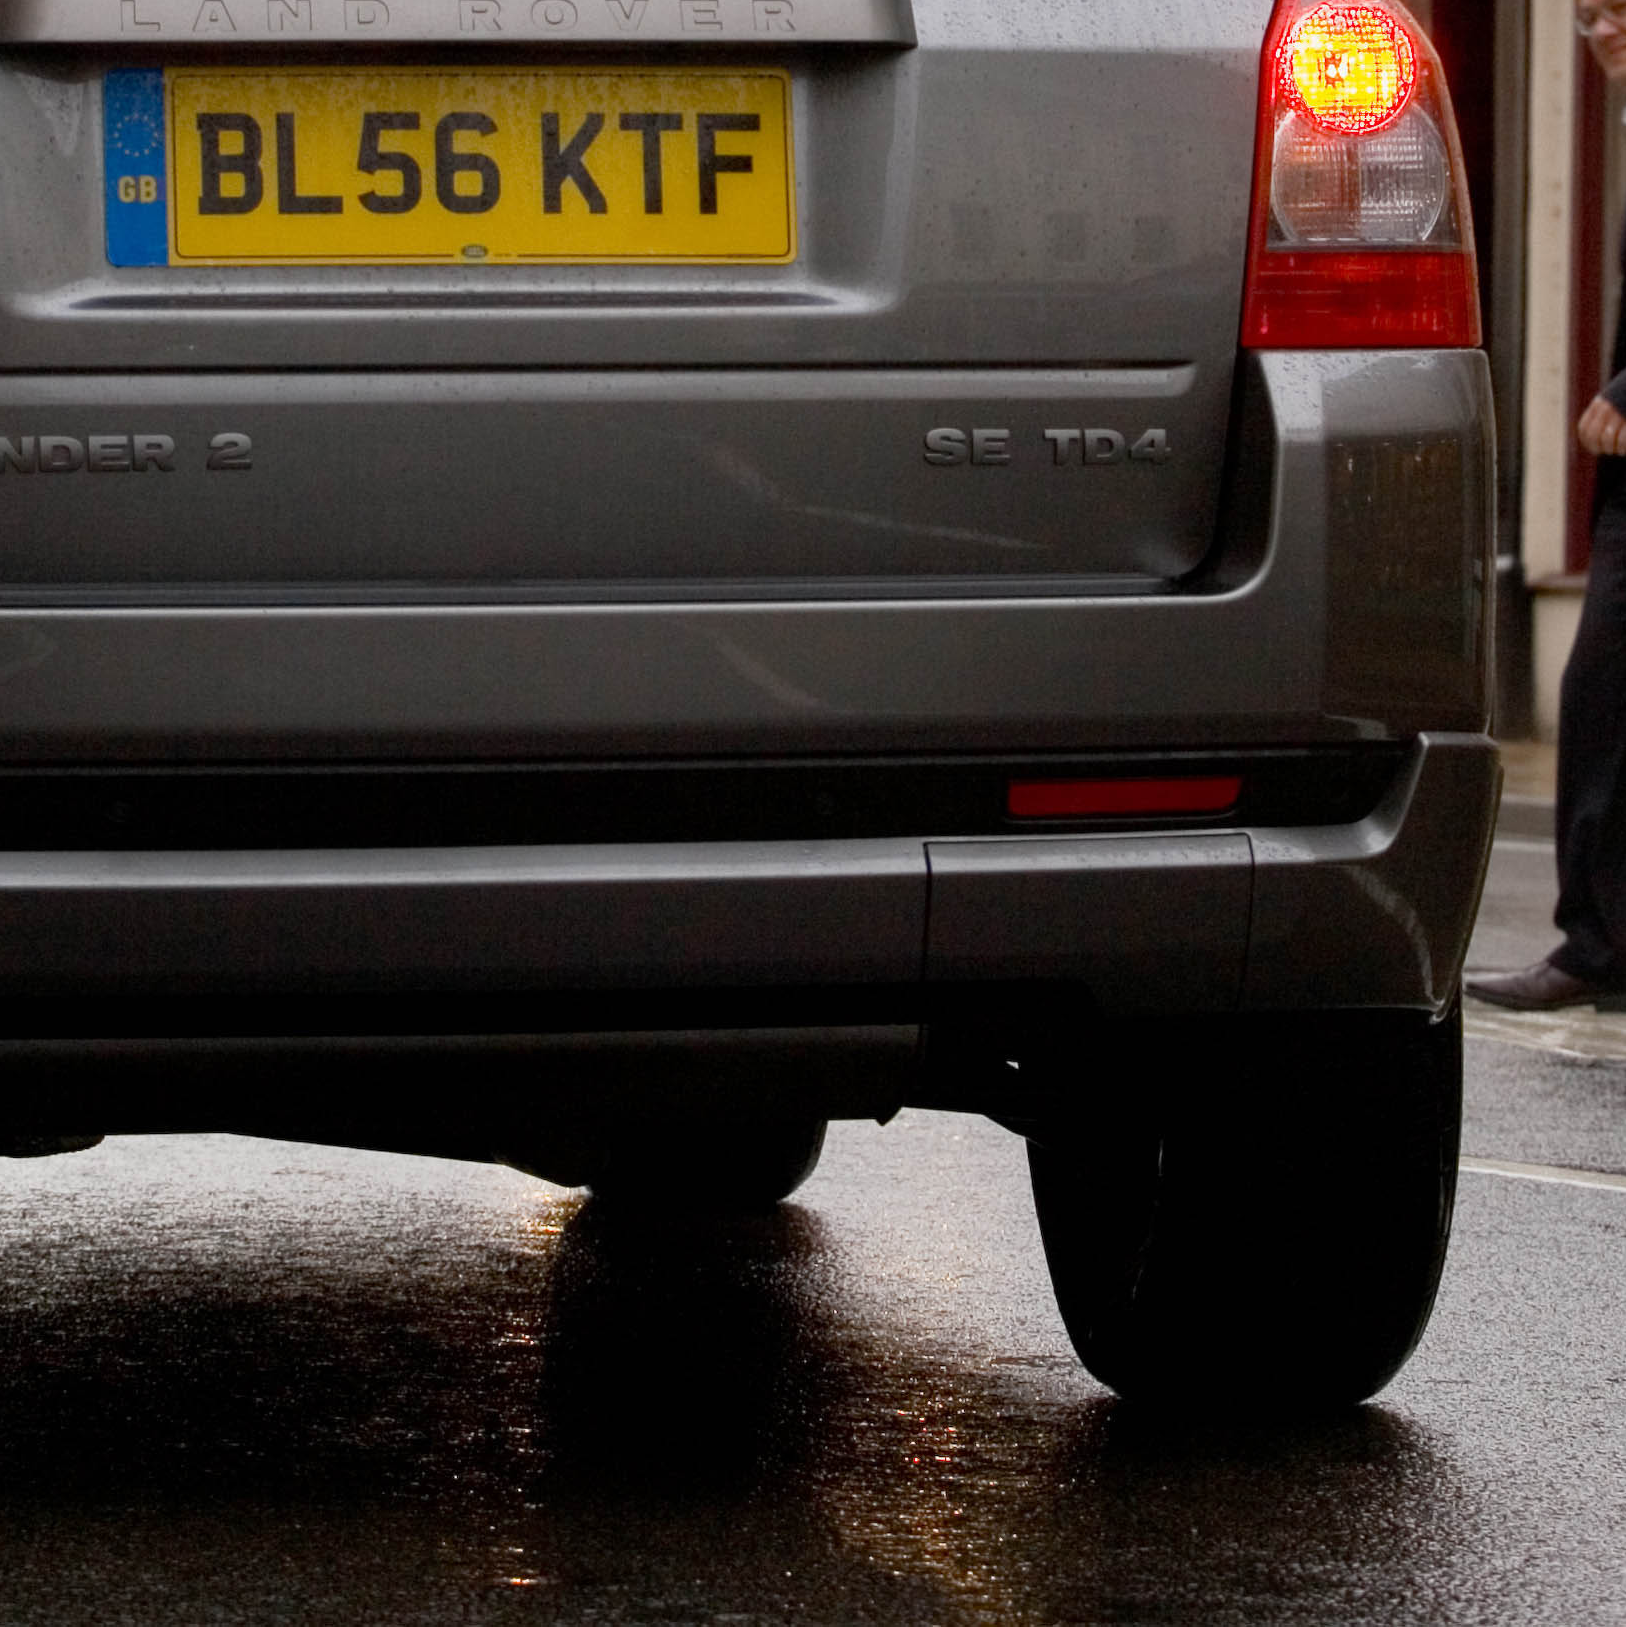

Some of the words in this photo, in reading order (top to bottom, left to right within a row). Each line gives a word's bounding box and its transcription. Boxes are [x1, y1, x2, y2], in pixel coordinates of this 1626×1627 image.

[195, 110, 503, 217] BL56
[539, 111, 763, 216] KTF
[117, 176, 158, 204] GB
[206, 431, 253, 472] 2
[924, 427, 1012, 466] SE
[1043, 428, 1173, 466] TD4
